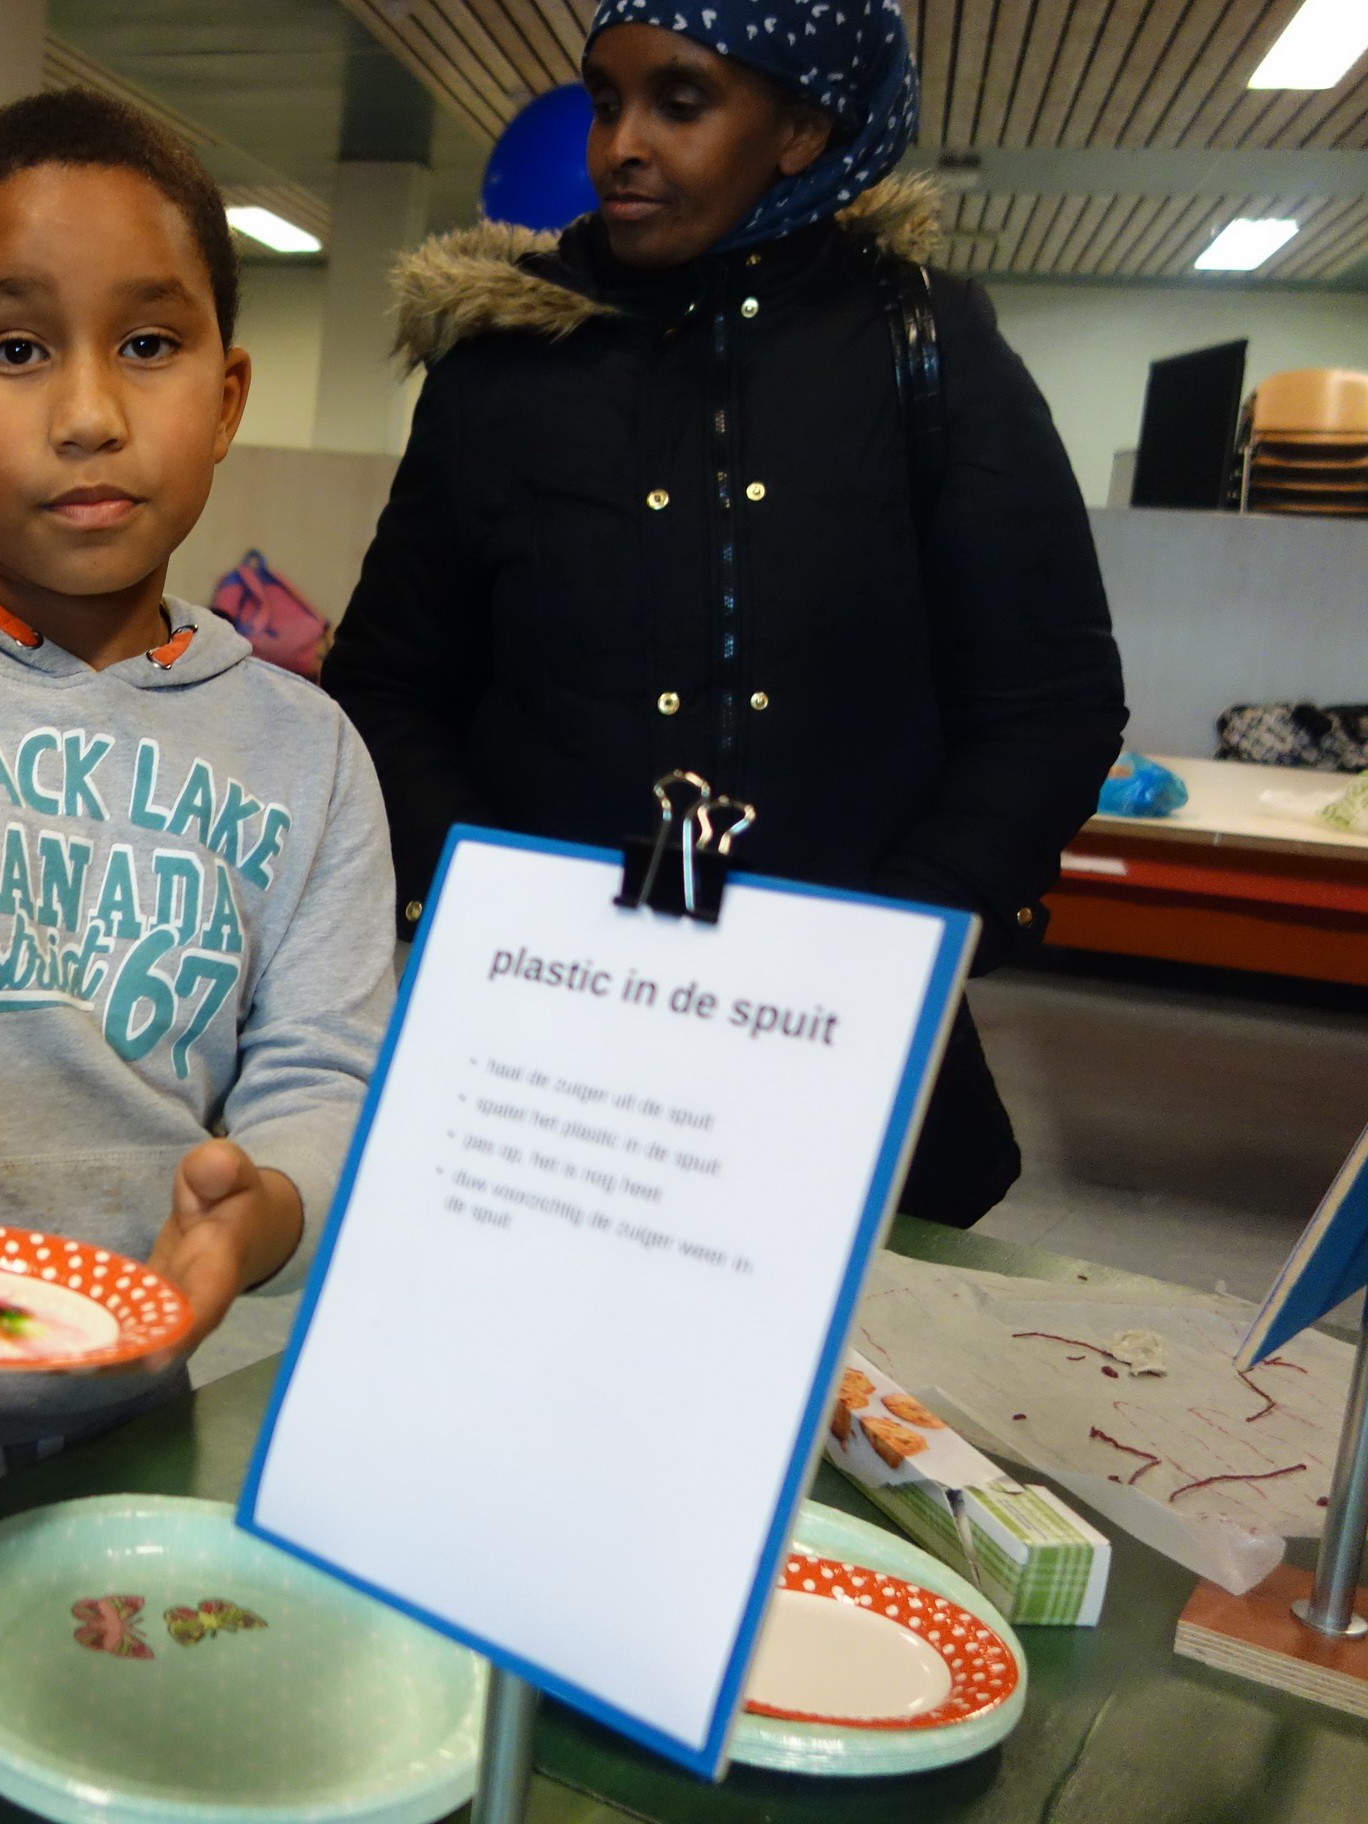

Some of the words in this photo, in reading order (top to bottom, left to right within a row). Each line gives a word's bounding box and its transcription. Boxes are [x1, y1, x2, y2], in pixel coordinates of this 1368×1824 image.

[129, 738, 292, 891] LAKE
[102, 924, 241, 1080] 67
[487, 945, 612, 997] plastic
[621, 967, 658, 1007] in
[669, 979, 718, 1020] de
[728, 998, 838, 1047] spuit
[527, 1069, 550, 1088] de
[640, 1099, 663, 1117] de
